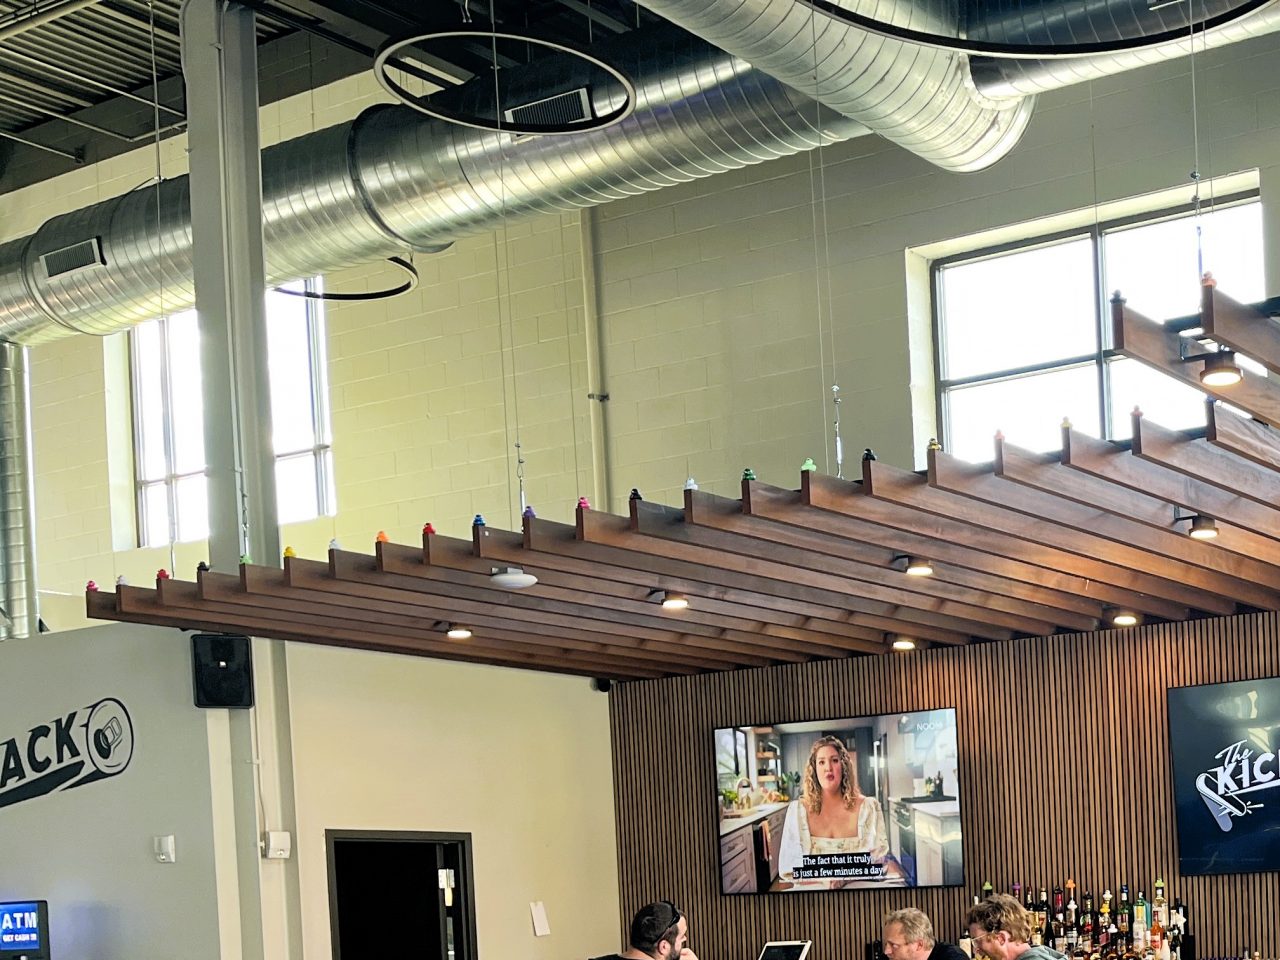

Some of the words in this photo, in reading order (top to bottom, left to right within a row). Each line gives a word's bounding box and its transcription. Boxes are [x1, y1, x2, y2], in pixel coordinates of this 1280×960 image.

[1215, 740, 1253, 767] The
[803, 857, 816, 865] The
[817, 856, 830, 864] fact
[831, 855, 846, 864] that
[846, 855, 853, 864] it
[853, 854, 871, 865] truly
[800, 869, 813, 878] just
[820, 868, 832, 876] few
[834, 867, 863, 876] minutes
[869, 866, 883, 877] day
[2, 912, 37, 929] ATM
